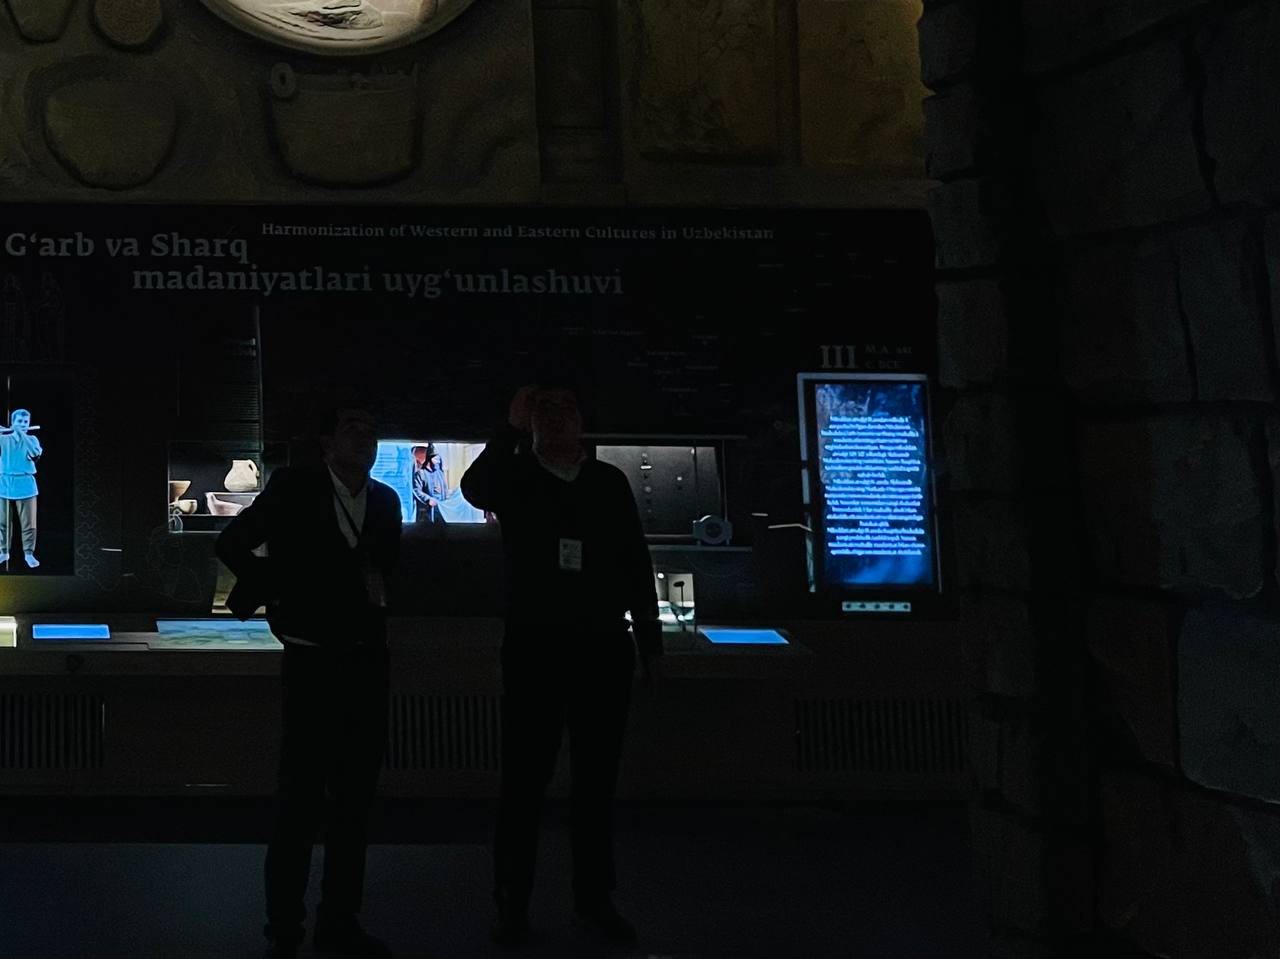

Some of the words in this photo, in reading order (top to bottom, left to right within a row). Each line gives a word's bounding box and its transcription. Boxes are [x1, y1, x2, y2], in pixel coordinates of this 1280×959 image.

[261, 222, 384, 238] Harmonization
[389, 223, 406, 238] of
[410, 224, 478, 238] Western
[483, 224, 513, 238] and
[519, 225, 580, 239] Eastern
[585, 225, 656, 240] Cultures
[661, 225, 677, 240] in
[682, 225, 774, 240] Uzbekistan
[105, 238, 140, 257] va
[150, 232, 249, 264] Sharq
[131, 264, 372, 296] madaniyatlari
